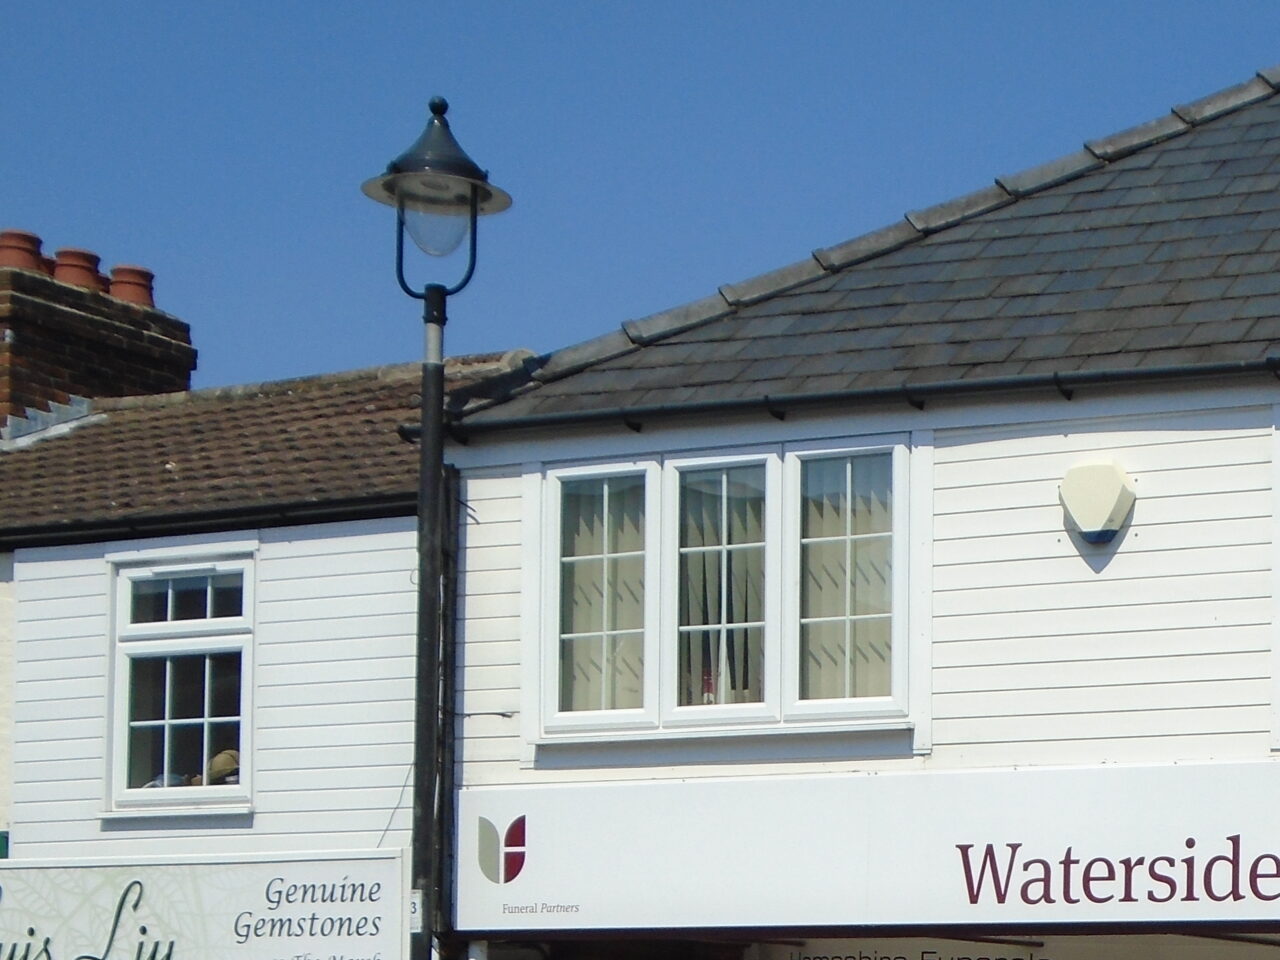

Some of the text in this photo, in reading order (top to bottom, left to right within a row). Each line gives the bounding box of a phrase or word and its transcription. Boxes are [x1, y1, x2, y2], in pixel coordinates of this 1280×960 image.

[264, 874, 382, 911] Genuine
[502, 902, 581, 914] Funeral Partners
[233, 907, 382, 945] Gemstones
